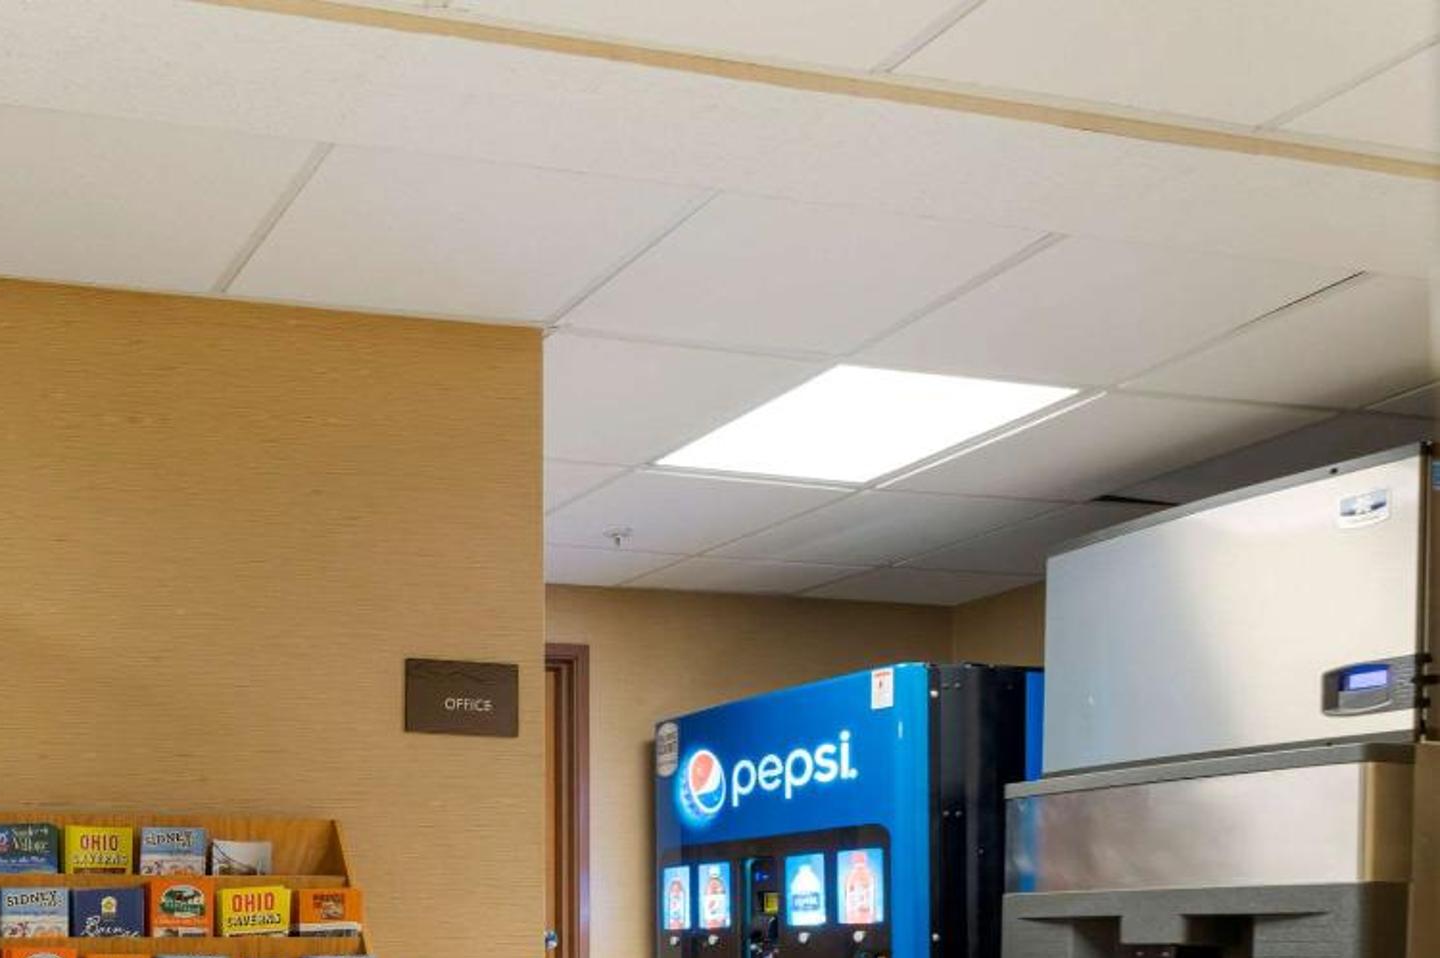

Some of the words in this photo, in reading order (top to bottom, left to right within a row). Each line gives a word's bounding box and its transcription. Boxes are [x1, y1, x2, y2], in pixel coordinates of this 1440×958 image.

[444, 697, 492, 711] OFFICE
[732, 729, 852, 806] pepsi
[80, 834, 119, 852] OHIO
[7, 890, 58, 907] SIDNEY
[232, 892, 275, 913] OHIO
